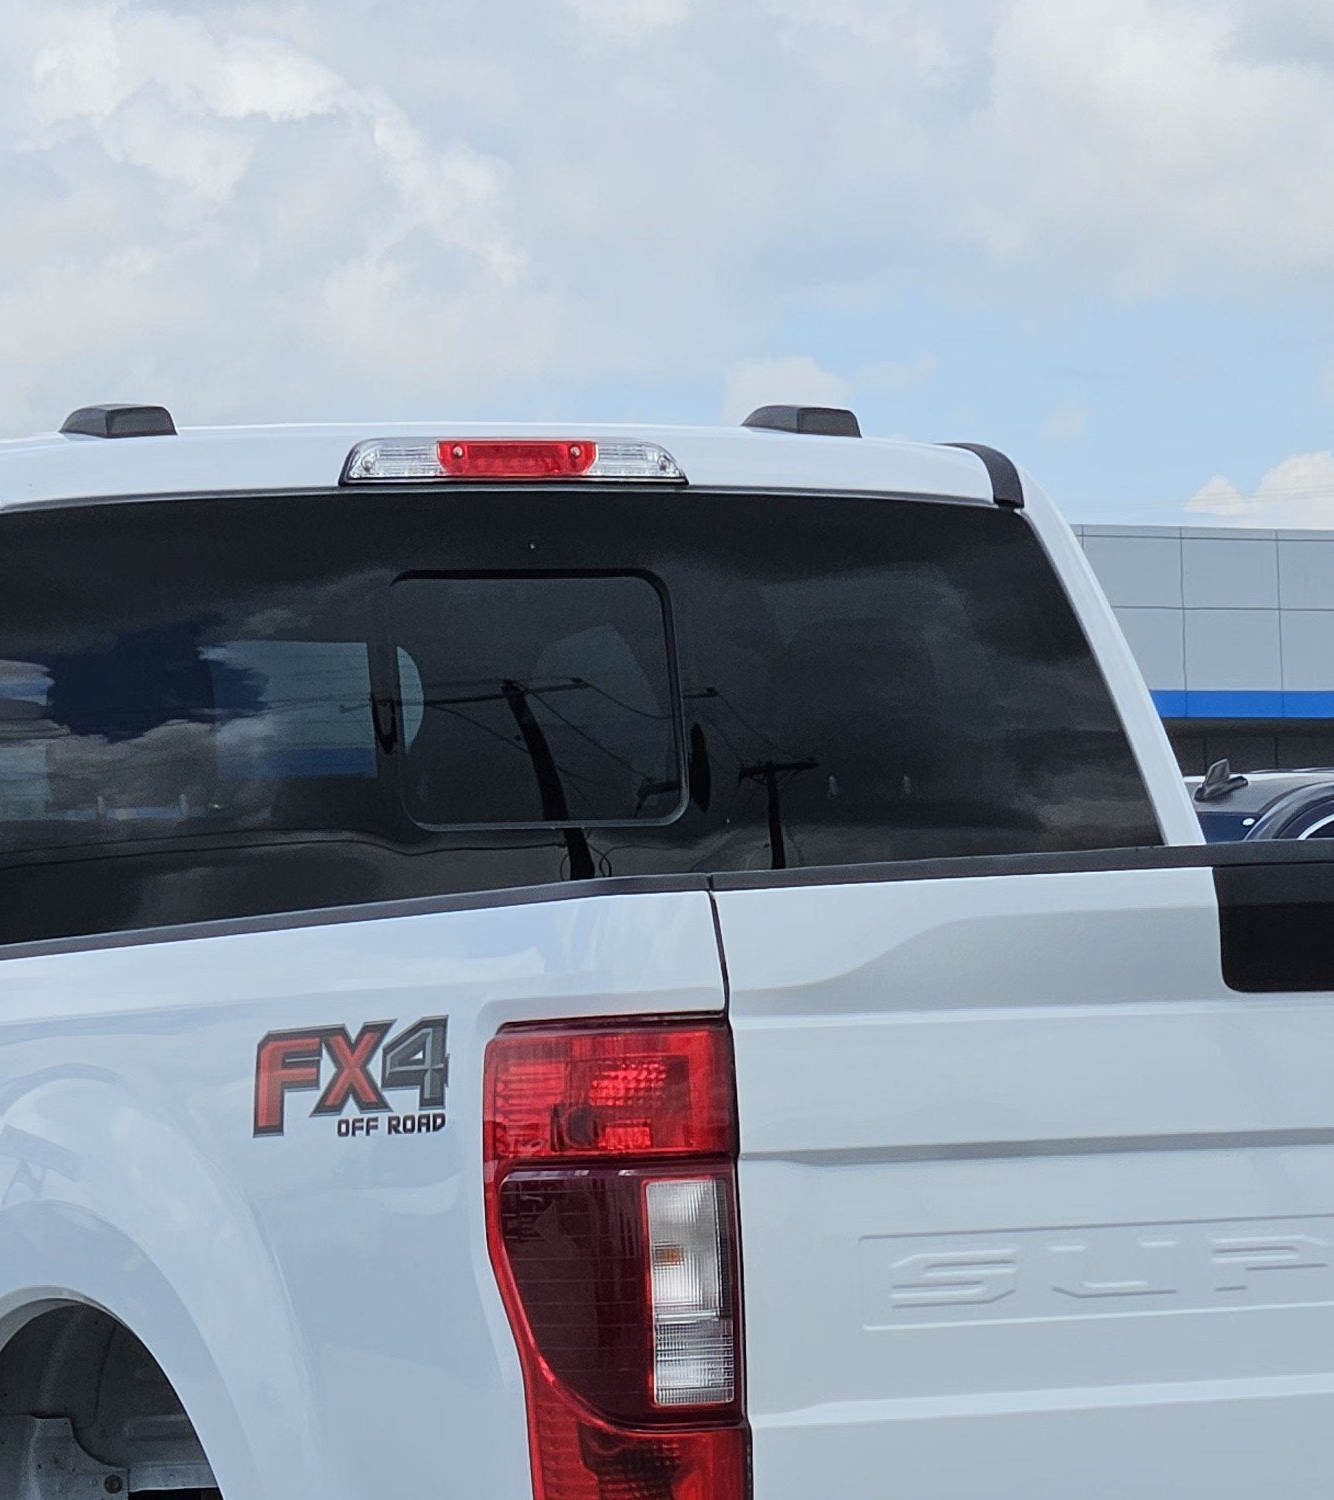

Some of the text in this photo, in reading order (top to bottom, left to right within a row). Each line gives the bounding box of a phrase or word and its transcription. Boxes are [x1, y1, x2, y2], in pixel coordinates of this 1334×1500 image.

[252, 1014, 450, 1138] FX4
[336, 1112, 446, 1137] OFF ROAD
